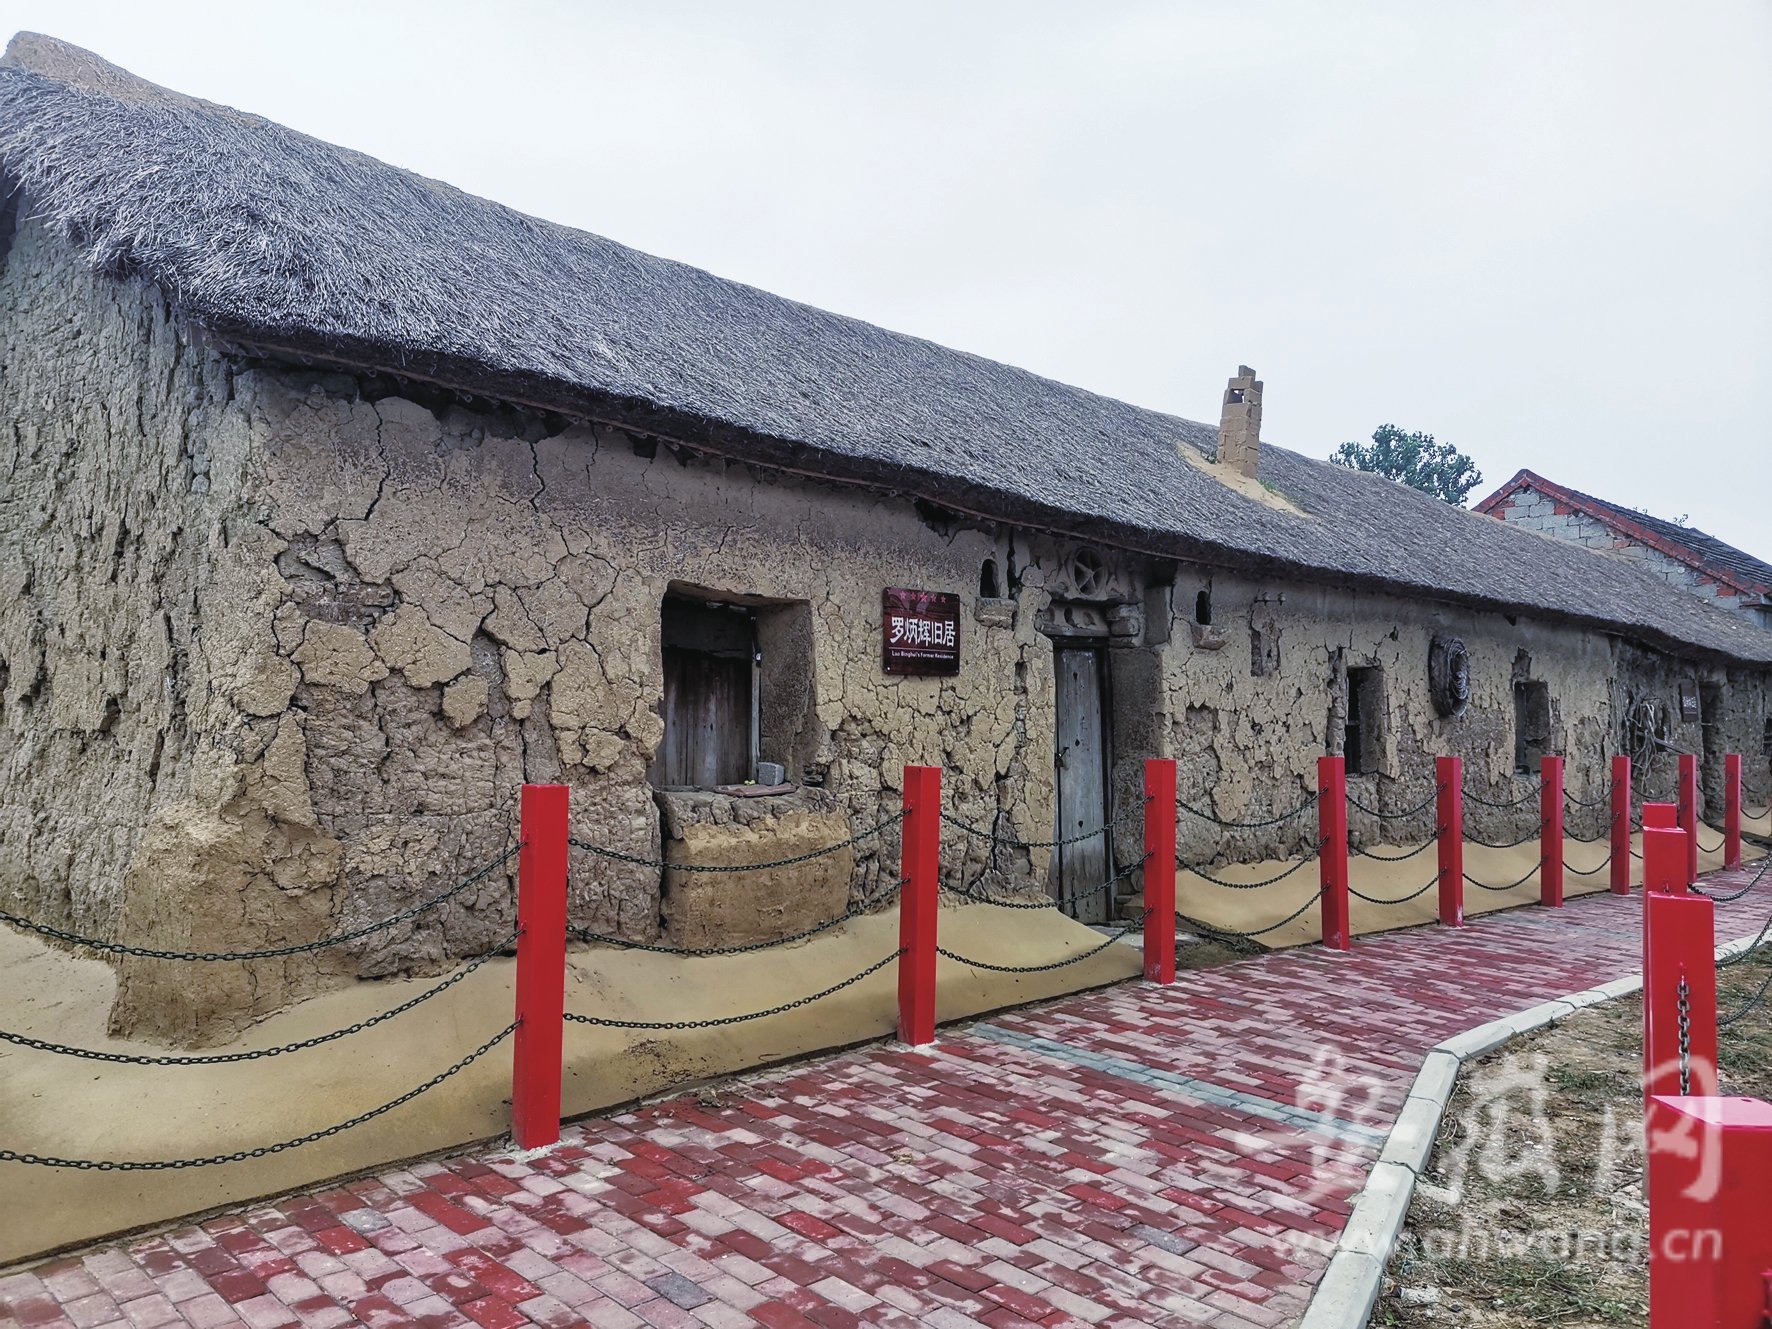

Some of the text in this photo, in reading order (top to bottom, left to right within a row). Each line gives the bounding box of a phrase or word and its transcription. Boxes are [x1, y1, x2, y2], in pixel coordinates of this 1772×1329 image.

[890, 617, 956, 646] 罗炳辉旧居
